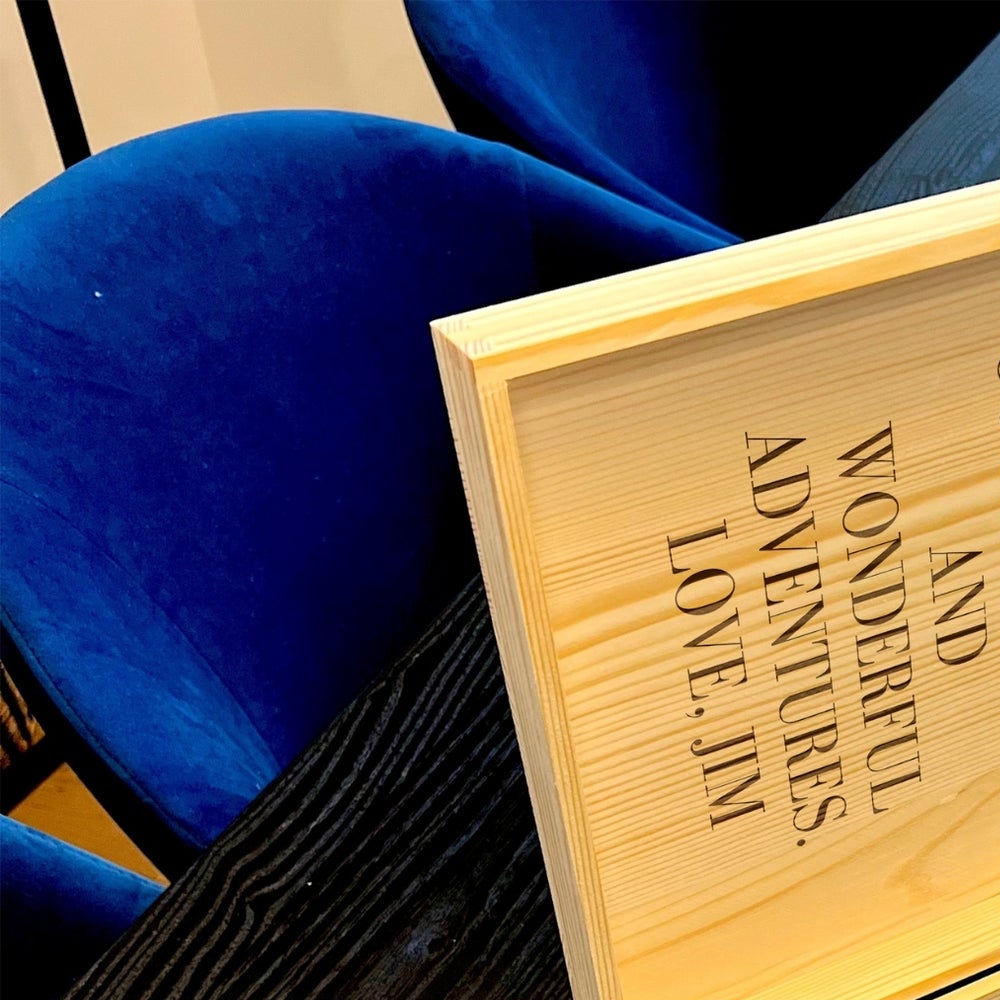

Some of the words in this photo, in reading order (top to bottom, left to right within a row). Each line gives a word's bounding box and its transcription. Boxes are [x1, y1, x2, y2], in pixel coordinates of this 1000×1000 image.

[667, 518, 748, 720] LOVE,
[745, 431, 848, 848] ADVENTURES.
[836, 420, 922, 815] WONDERFUL
[928, 546, 988, 666] AND
[690, 726, 766, 831] JIM
